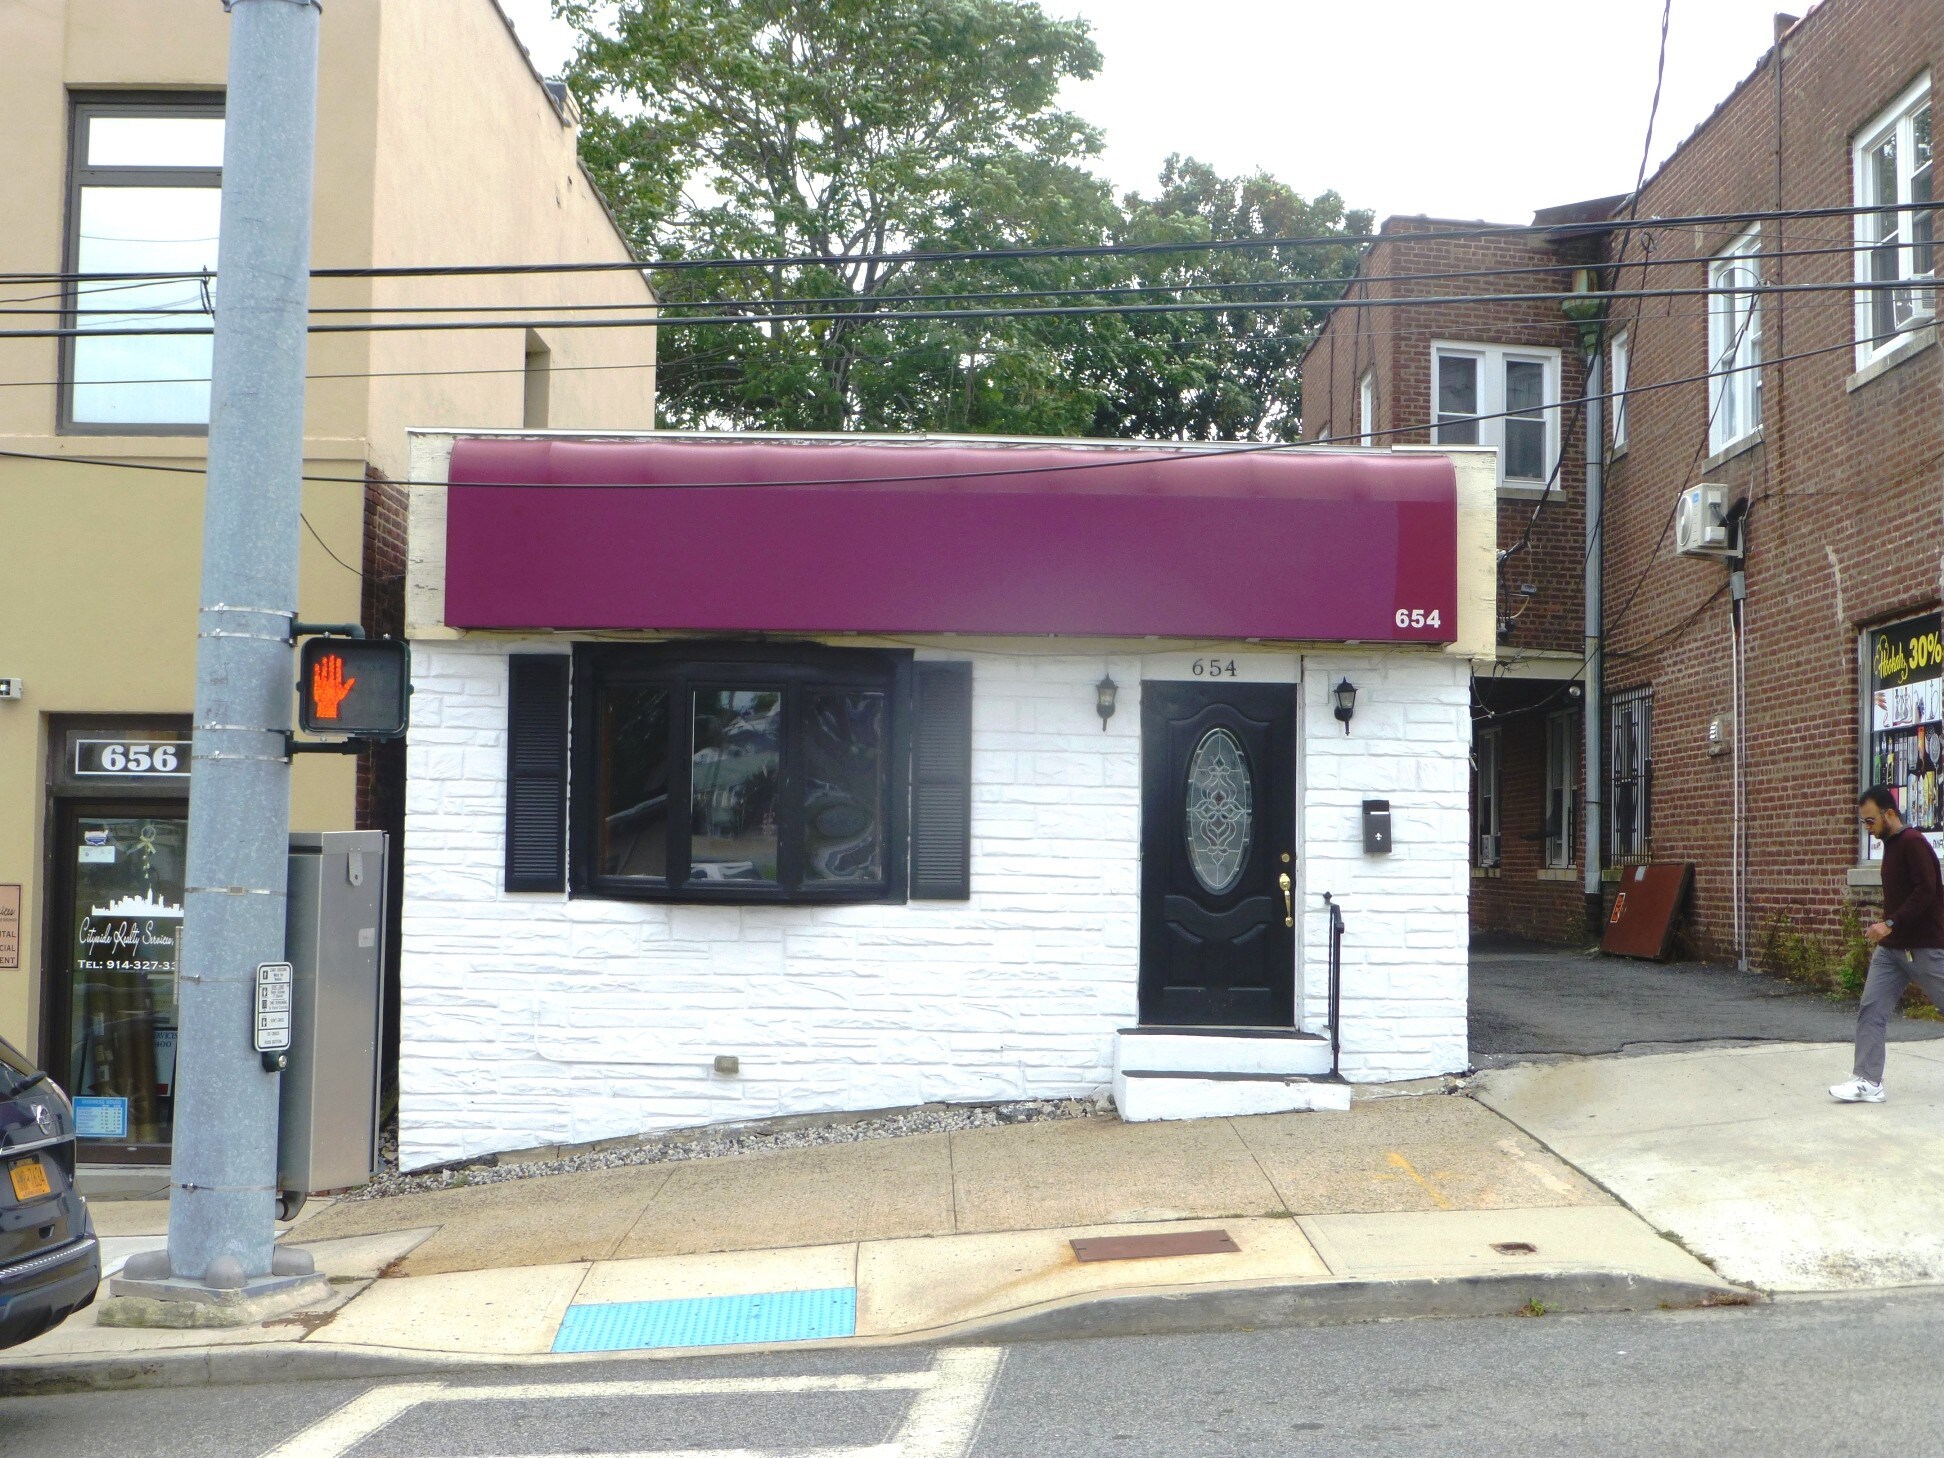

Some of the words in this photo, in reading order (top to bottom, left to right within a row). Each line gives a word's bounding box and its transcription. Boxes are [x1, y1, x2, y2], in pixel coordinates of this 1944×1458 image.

[1395, 609, 1441, 628] 654
[1909, 631, 1942, 669] 30%
[1192, 658, 1237, 677] 654
[102, 744, 178, 771] 656
[80, 917, 112, 956] Citywide
[112, 921, 140, 956] Realty
